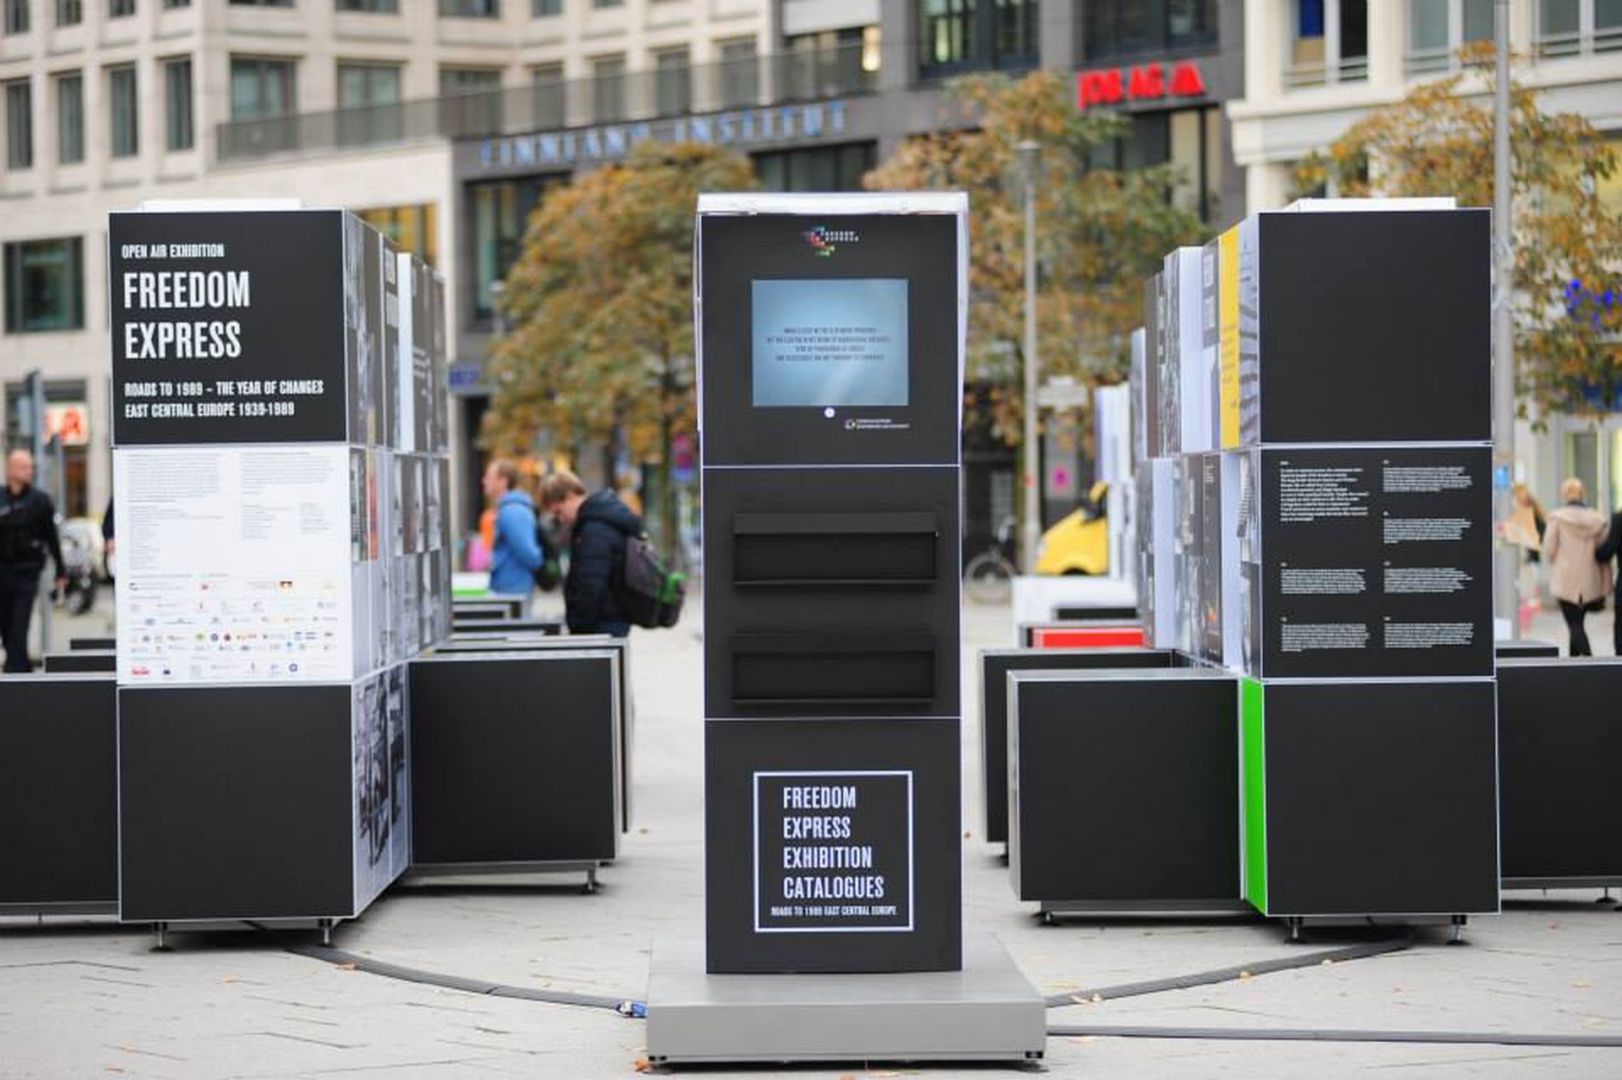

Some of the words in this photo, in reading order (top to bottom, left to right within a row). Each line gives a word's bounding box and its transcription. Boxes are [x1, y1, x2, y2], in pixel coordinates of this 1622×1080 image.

[121, 243, 147, 259] OPEN
[150, 243, 168, 259] AIR
[169, 243, 225, 259] EXHIBITION
[123, 270, 251, 309] FREEDOM
[124, 320, 242, 359] EXPRESS
[124, 382, 157, 397] ROADS
[159, 382, 173, 397] TO
[176, 381, 204, 396] 1989
[216, 381, 235, 396] THE
[236, 381, 262, 395] YEAR
[264, 380, 278, 395] OF
[279, 379, 325, 395] CHANGES
[125, 403, 149, 418] EAST
[151, 403, 195, 418] CENTRAL
[197, 402, 236, 417] EUROPE
[783, 785, 857, 809] FREEDOM
[783, 815, 851, 840] EXPRESS
[783, 845, 873, 870] EXHIBITION
[783, 875, 885, 900] CATALOGUES
